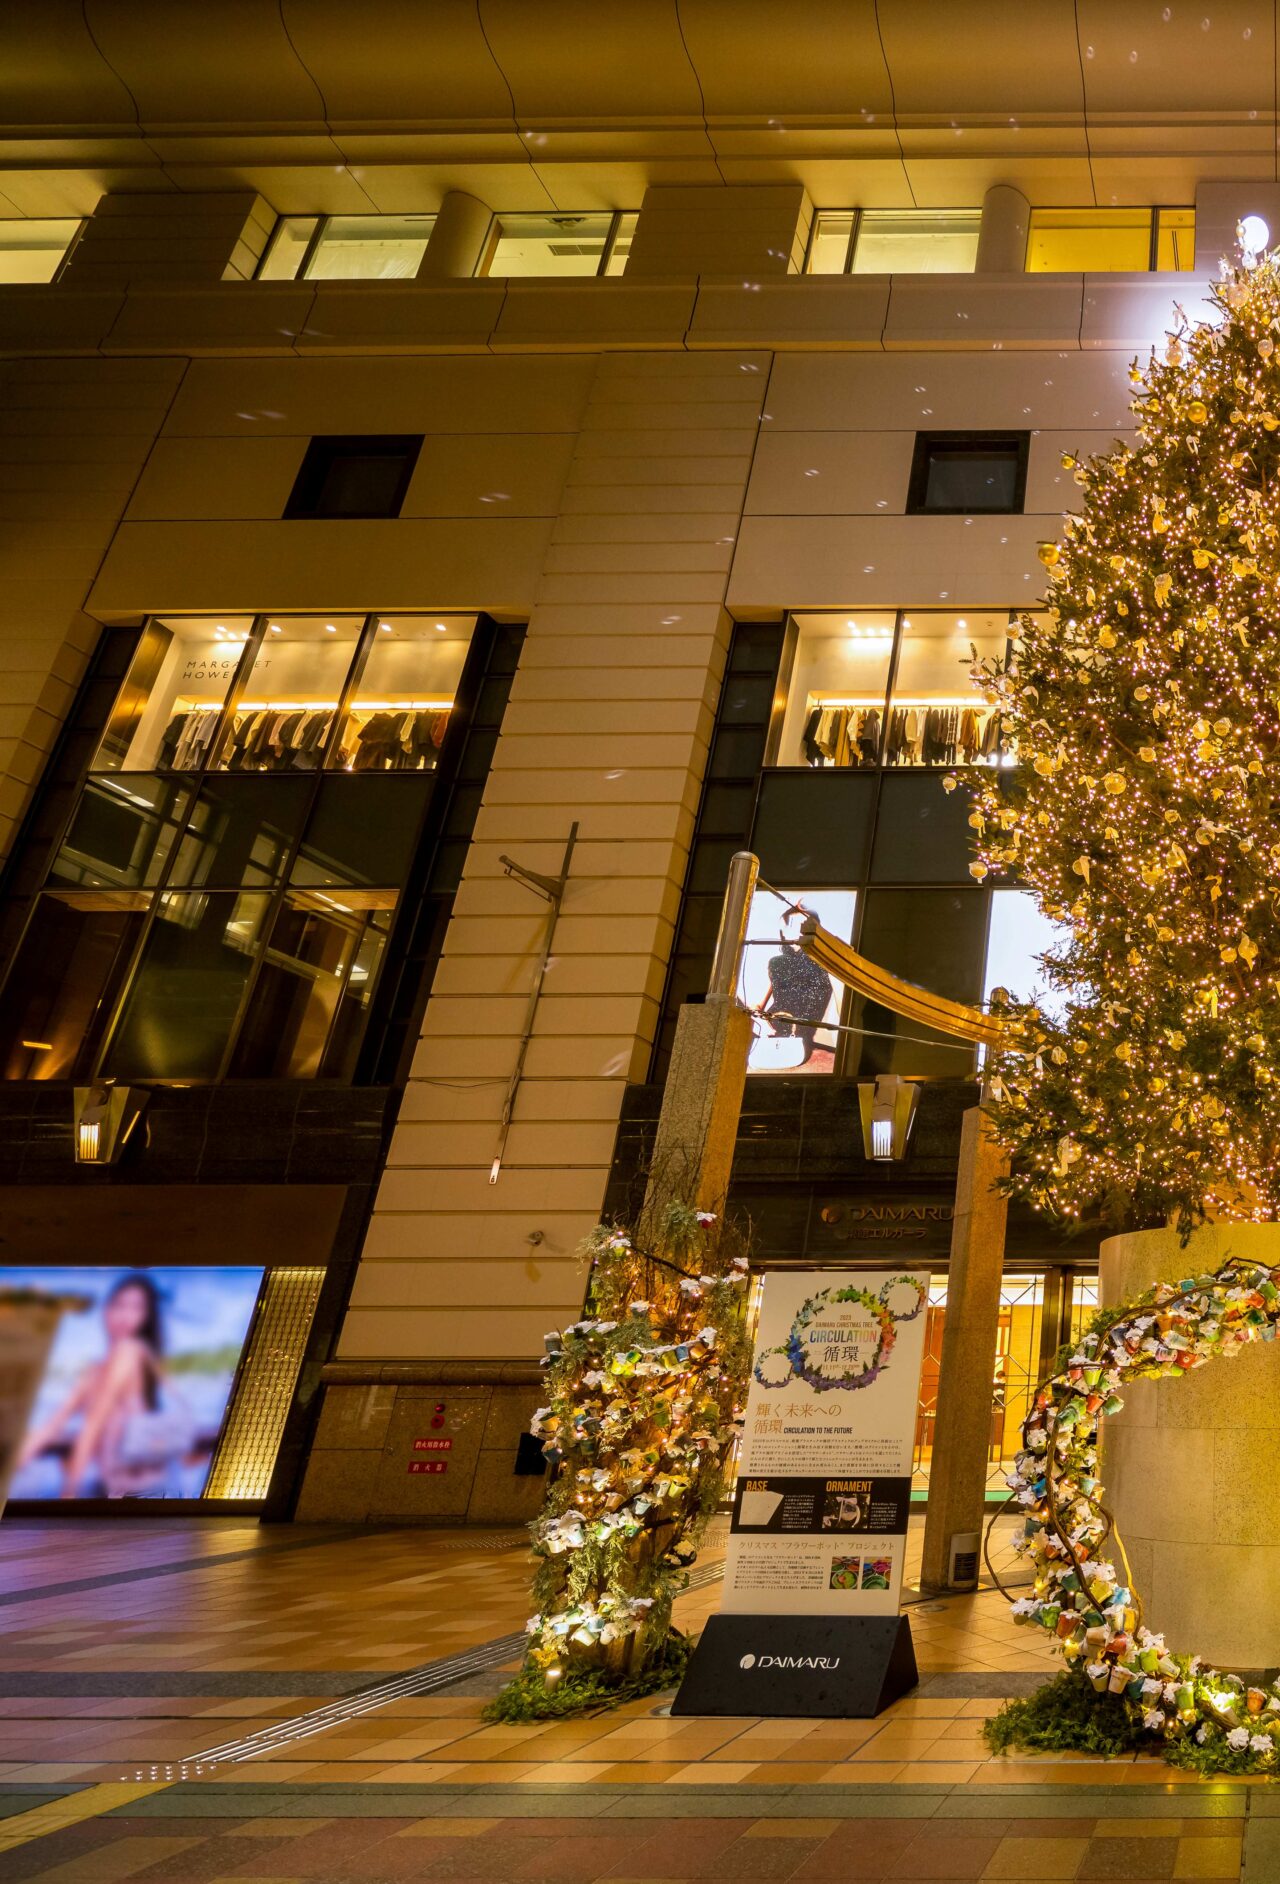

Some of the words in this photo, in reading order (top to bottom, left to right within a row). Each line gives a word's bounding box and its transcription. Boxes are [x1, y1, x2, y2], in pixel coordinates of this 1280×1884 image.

[186, 660, 272, 668] MARGAET
[183, 671, 230, 679] HOWE
[850, 1207, 954, 1220] DAIMARU
[809, 1330, 877, 1343] CIRCULATION
[824, 1345, 860, 1363] 循環
[756, 1403, 842, 1418] 輝く未来への
[754, 1419, 783, 1435] 循環
[746, 1480, 768, 1492] BASE
[826, 1480, 873, 1492] ORNAMENT
[738, 1541, 777, 1549] クリスマス
[849, 1541, 895, 1550] プロジェクト
[757, 1656, 840, 1669] DAIMARU
